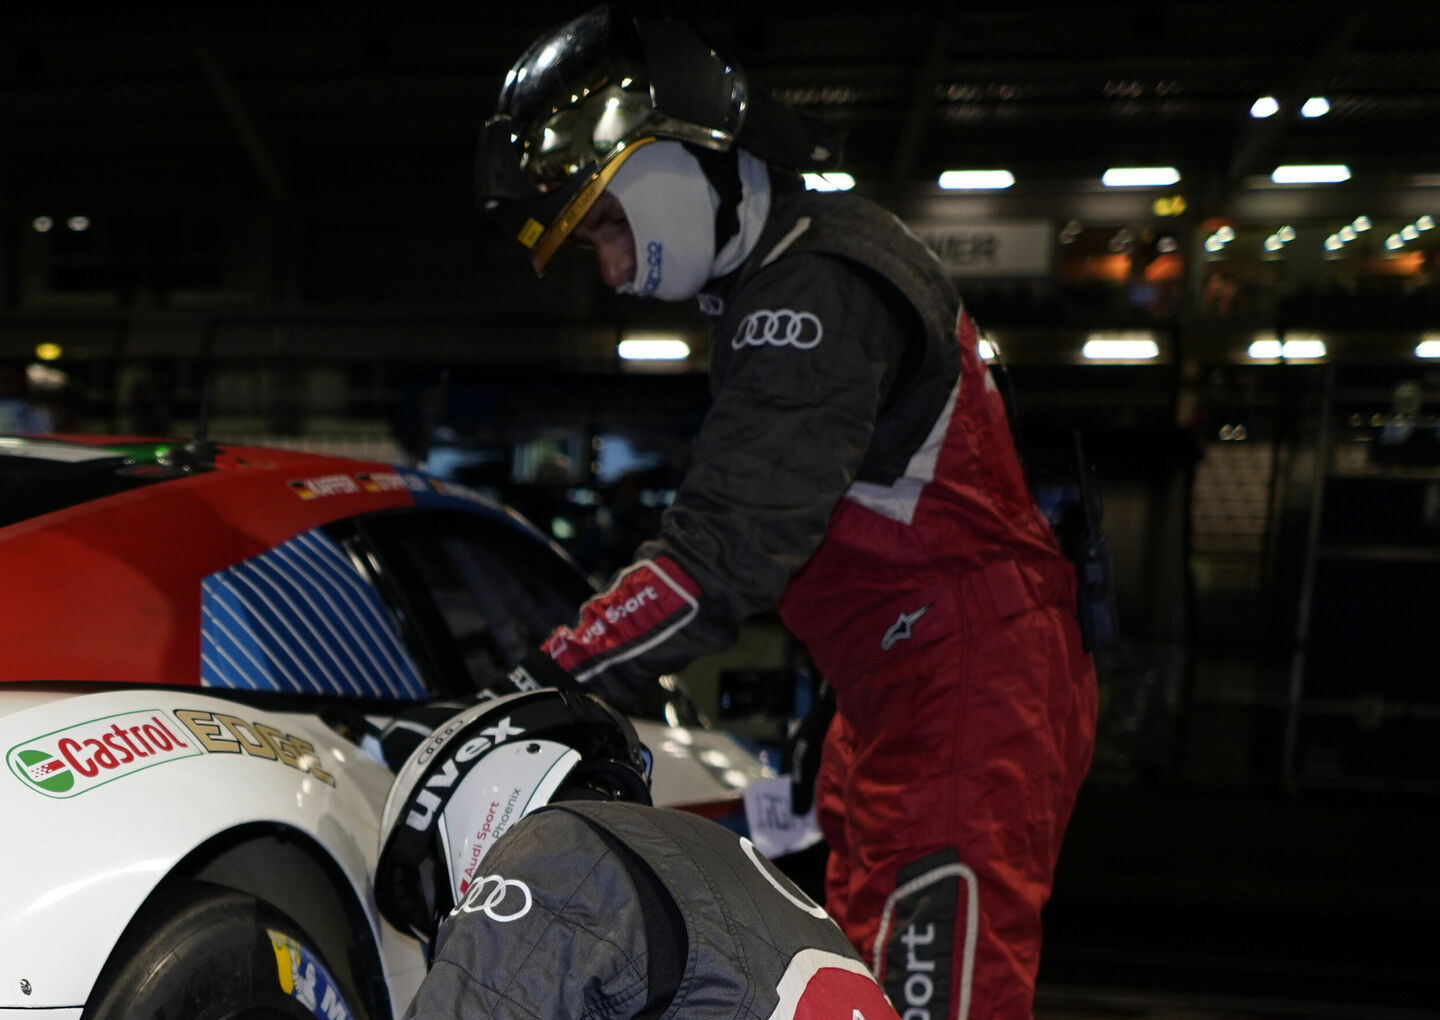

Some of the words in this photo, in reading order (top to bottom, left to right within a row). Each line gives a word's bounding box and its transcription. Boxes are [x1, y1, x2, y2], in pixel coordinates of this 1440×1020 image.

[57, 716, 188, 778] Castrol
[173, 708, 336, 788] EDGE
[405, 715, 527, 832] uvex
[465, 844, 483, 877] Audi
[476, 801, 500, 841] Sport
[492, 787, 522, 840] Phoenix
